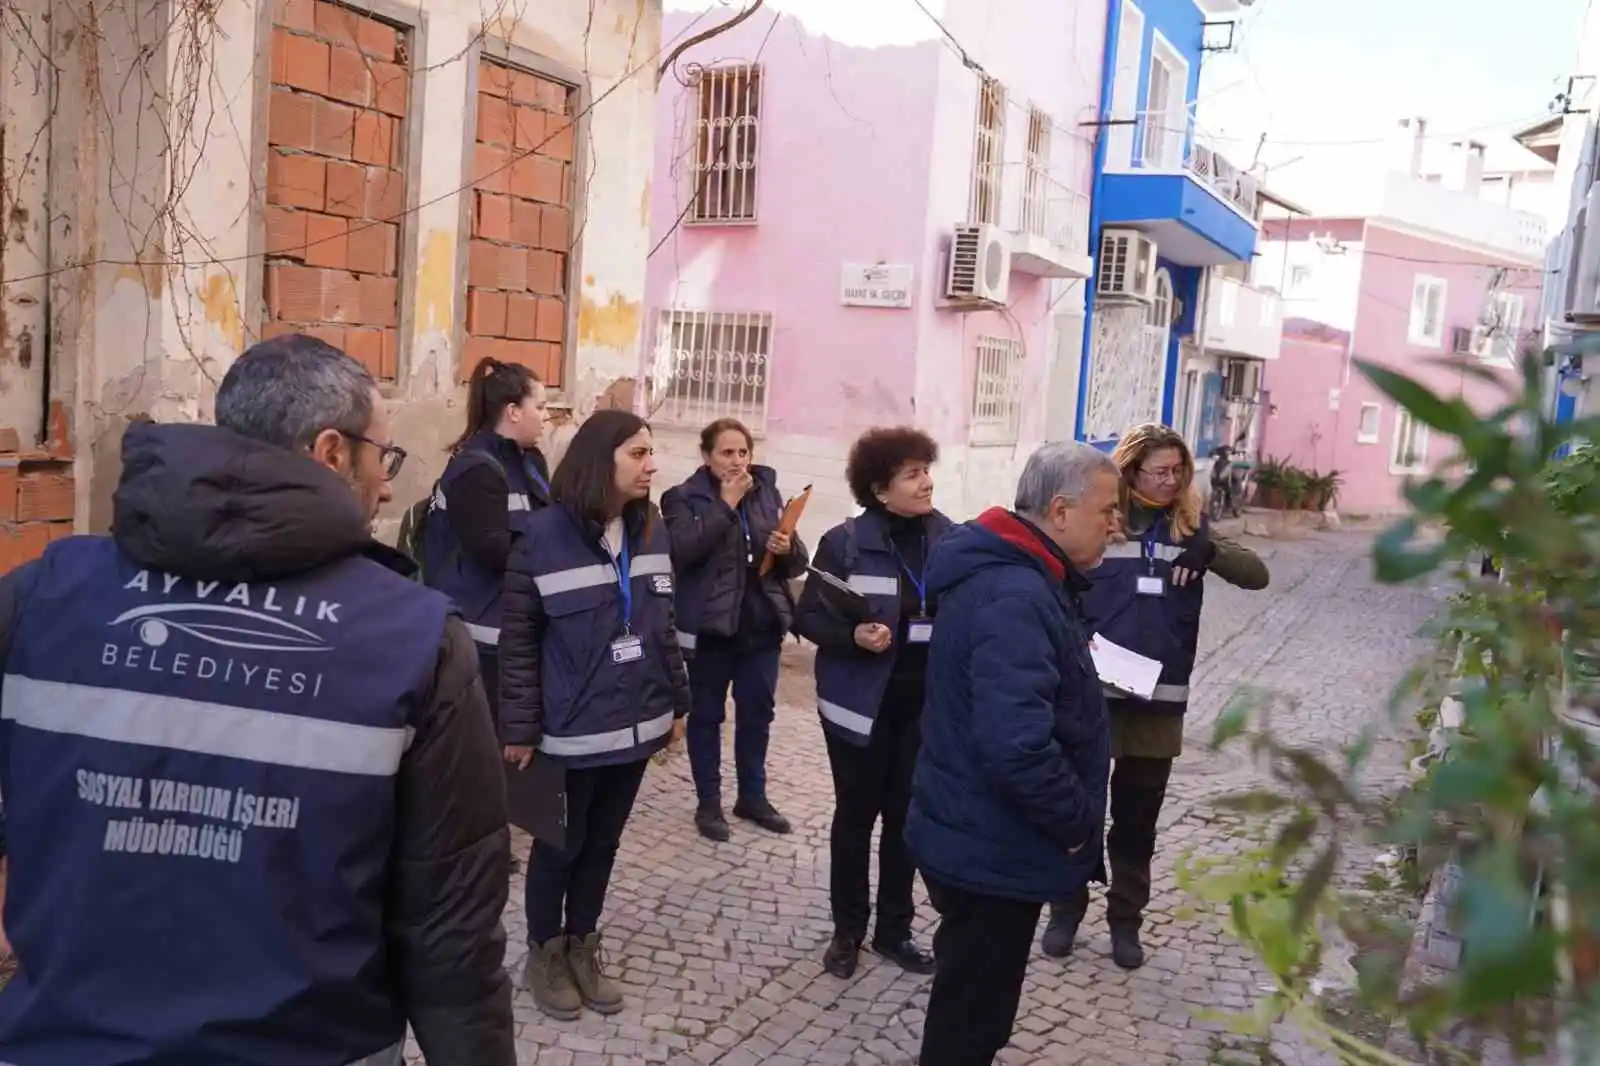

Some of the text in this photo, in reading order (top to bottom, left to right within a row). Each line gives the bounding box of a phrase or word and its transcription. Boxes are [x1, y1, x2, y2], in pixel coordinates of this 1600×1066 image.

[123, 570, 342, 623] AYVALIK
[101, 644, 322, 697] BELEDİYESİ
[76, 768, 299, 830] SOSYAL YARDIM İŞLERİ
[103, 816, 243, 863] MÜDÜRLÜĞÜ
